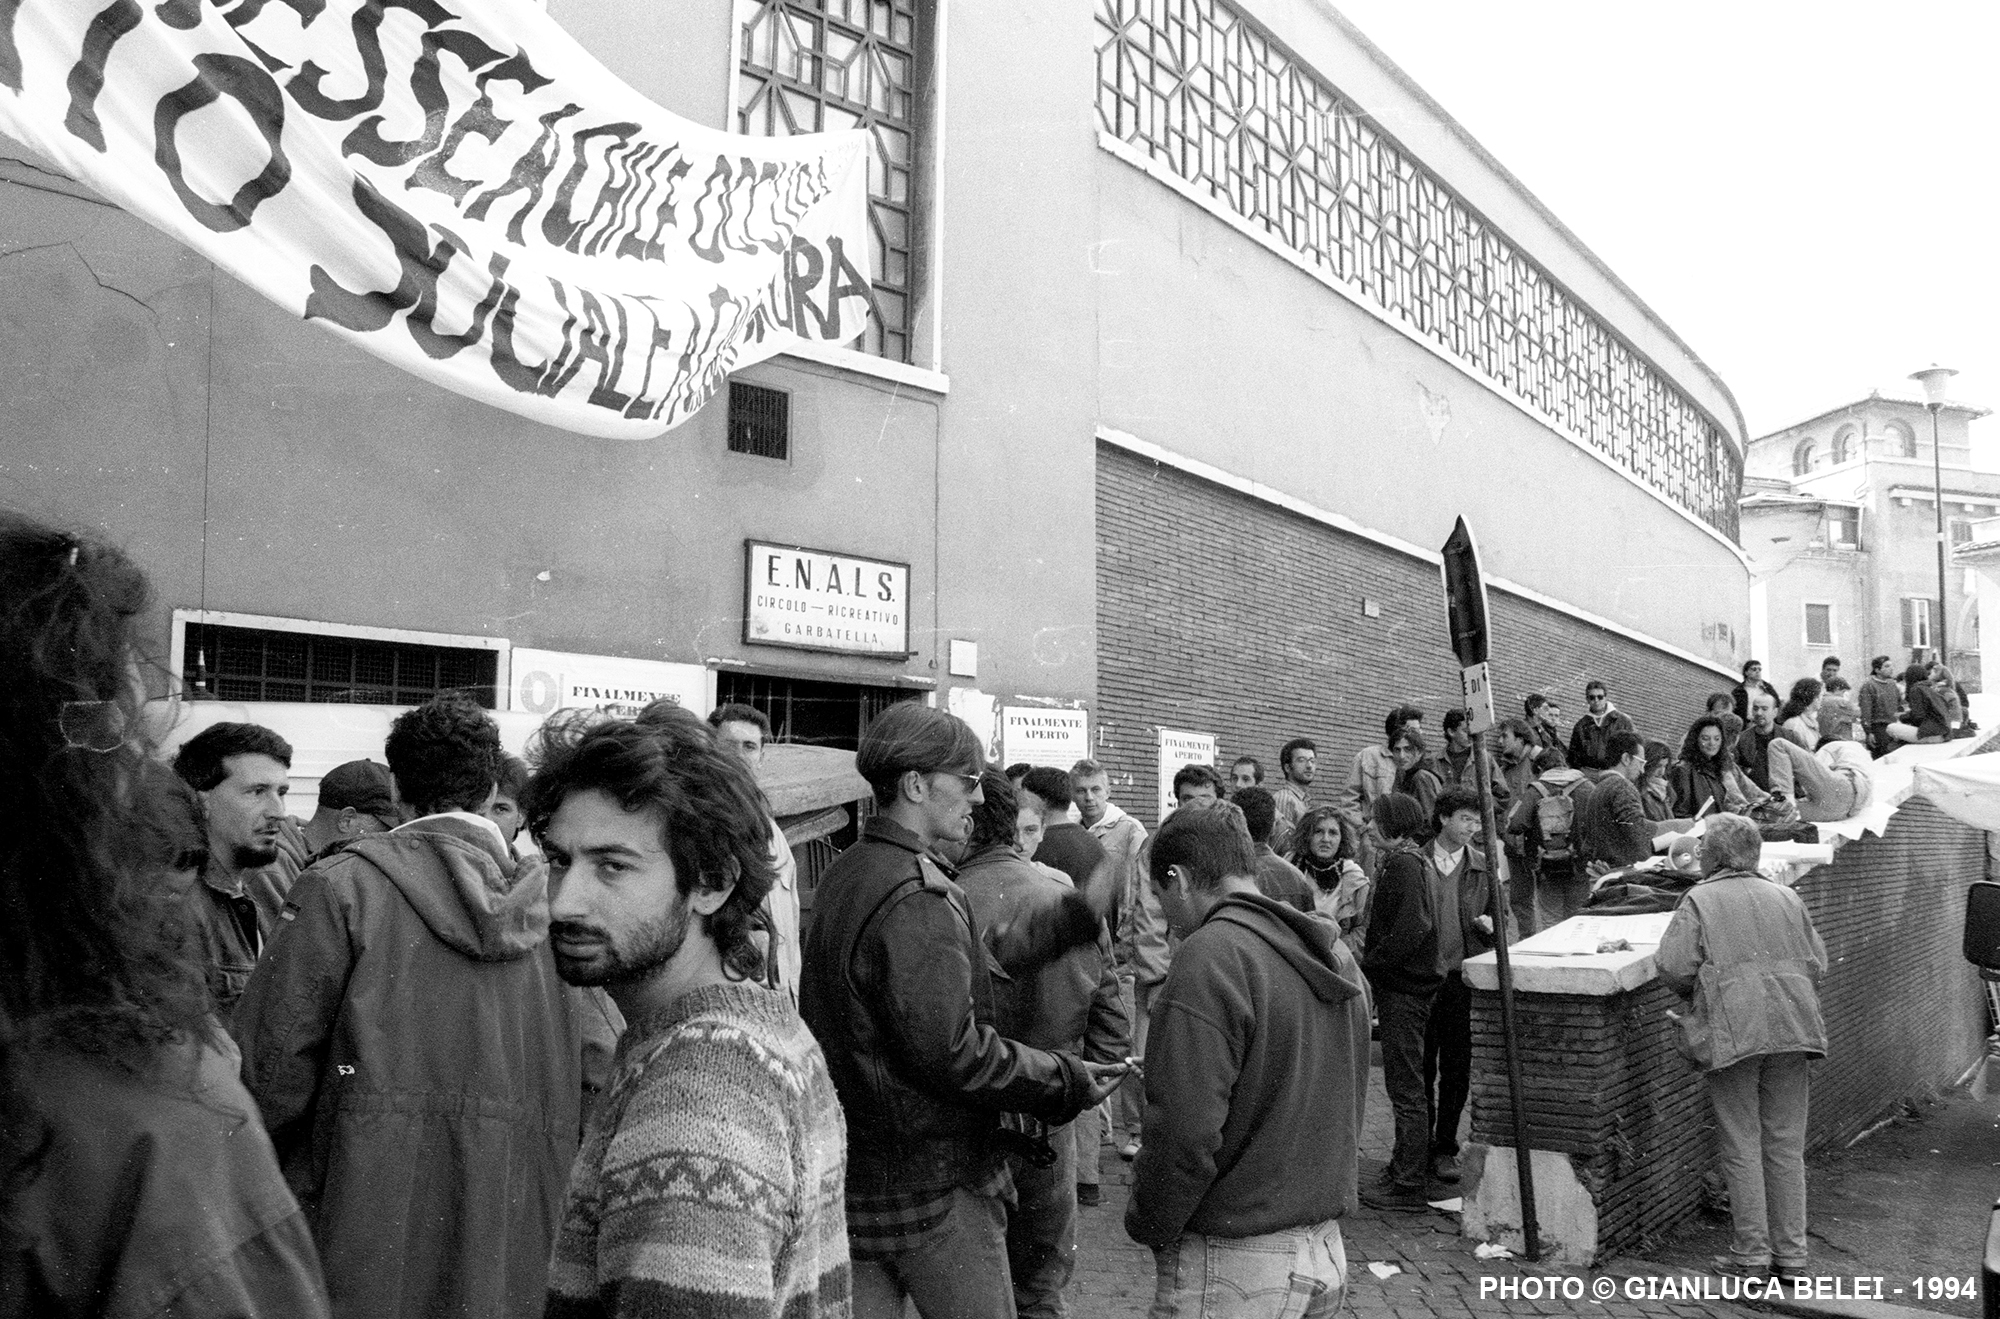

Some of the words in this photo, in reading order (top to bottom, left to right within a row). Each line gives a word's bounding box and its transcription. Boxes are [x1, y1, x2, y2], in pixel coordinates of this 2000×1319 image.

[757, 595, 807, 613] CIRCOLO
[828, 605, 898, 626] RICREATIVO
[784, 622, 878, 644] GARBATELLA
[1010, 716, 1082, 729] FINALMENTE
[1025, 730, 1070, 740] APERTO
[1165, 738, 1212, 752] FINALMENTE
[1174, 751, 1203, 761] APERTO
